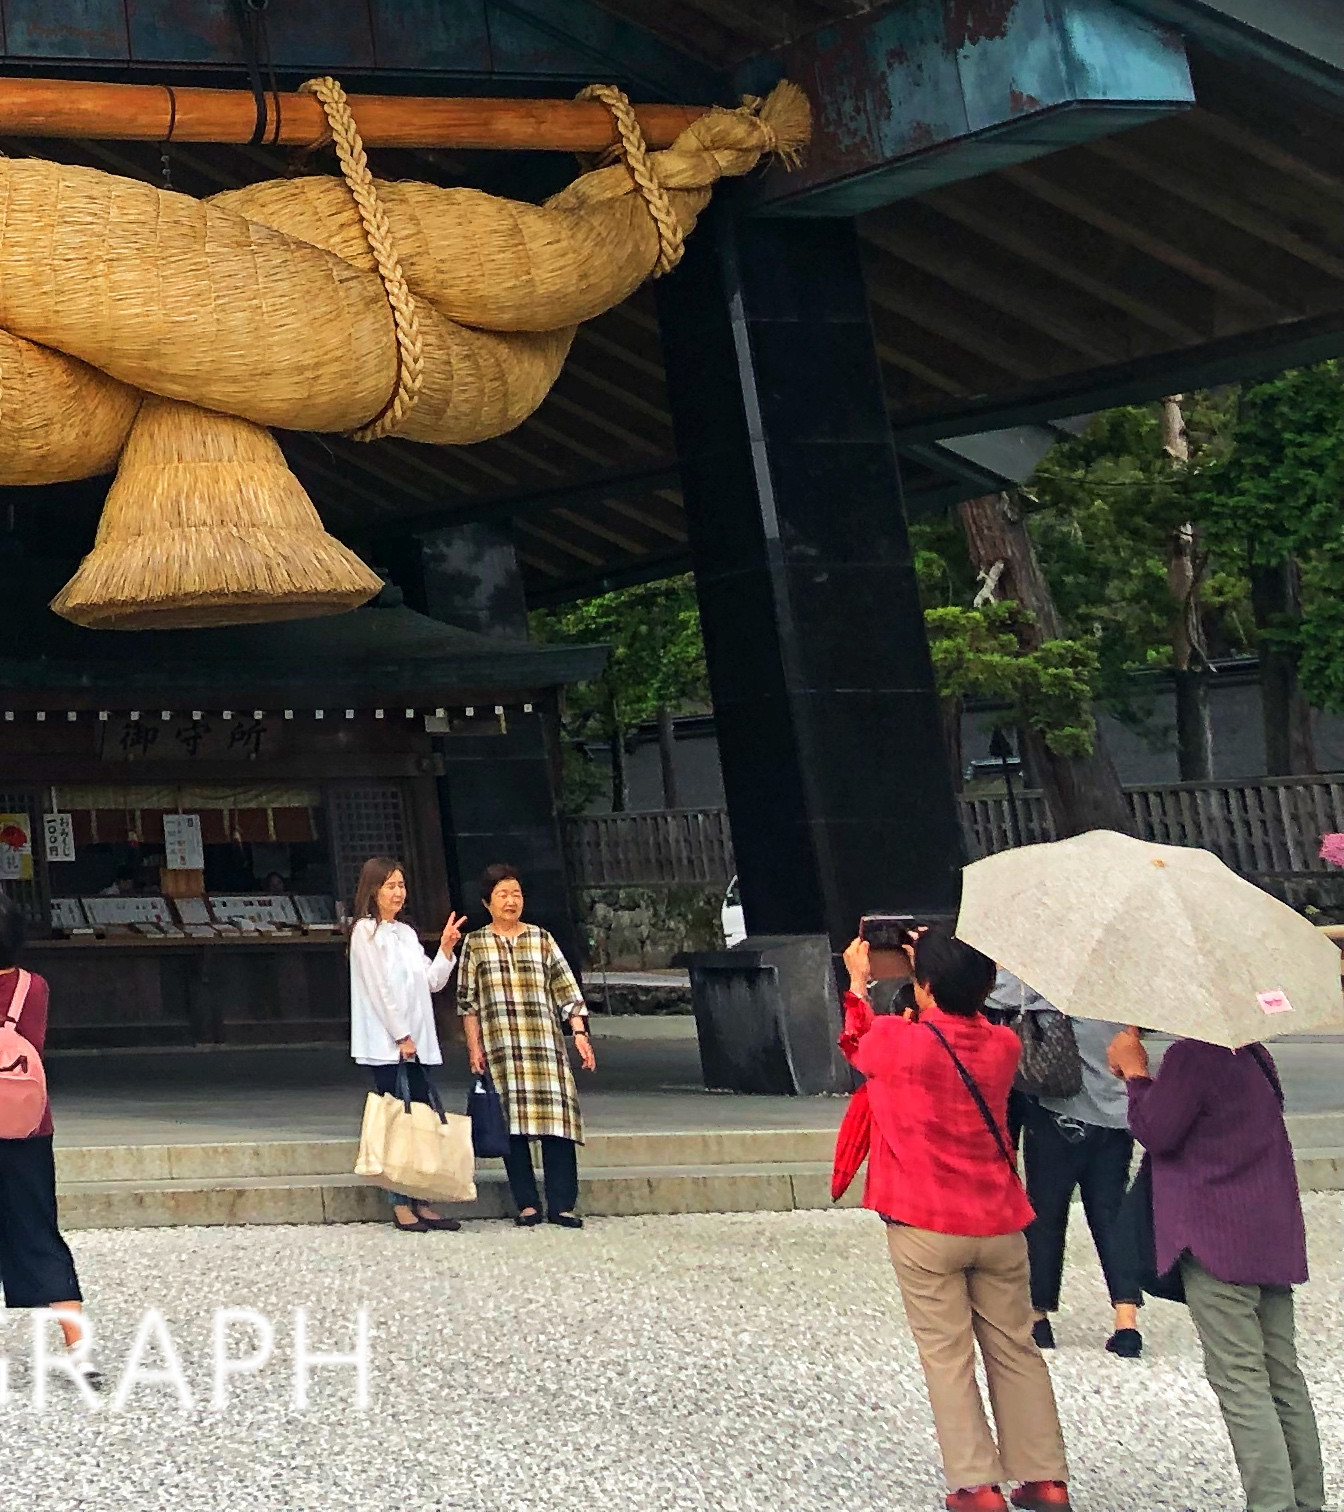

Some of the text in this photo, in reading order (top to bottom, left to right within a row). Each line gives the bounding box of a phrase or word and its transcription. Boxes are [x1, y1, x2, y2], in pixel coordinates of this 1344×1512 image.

[120, 719, 267, 756] 御守所
[59, 816, 70, 857] おみくじ
